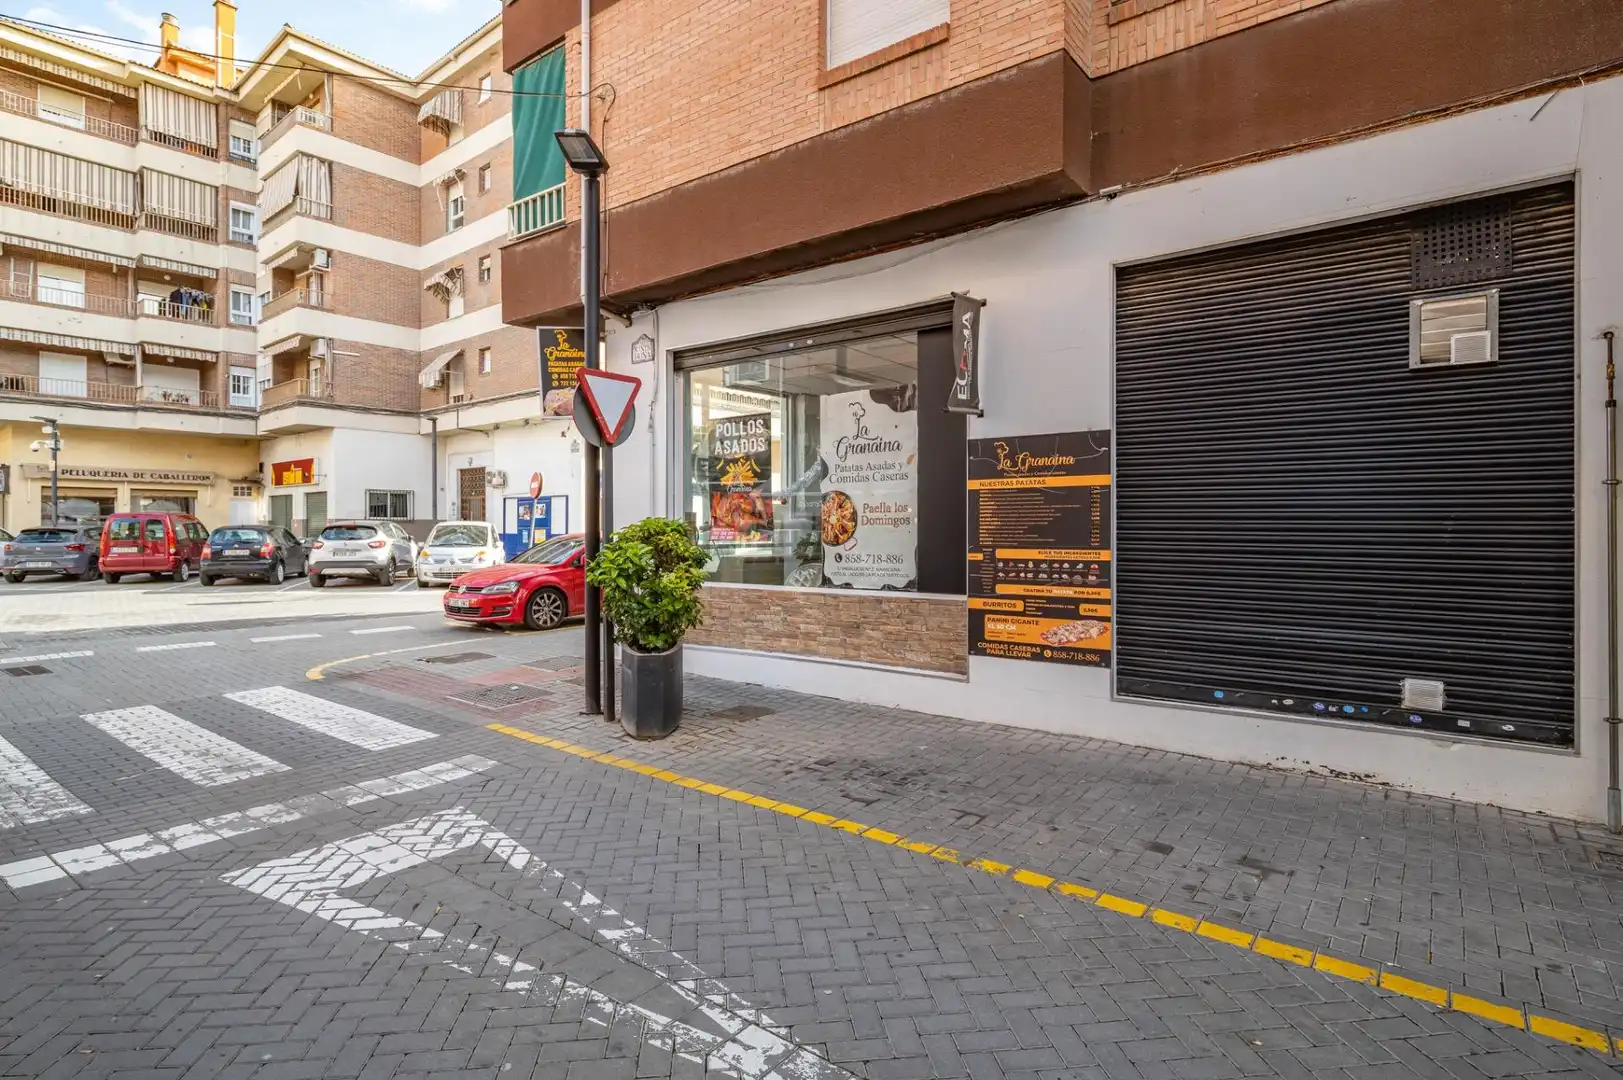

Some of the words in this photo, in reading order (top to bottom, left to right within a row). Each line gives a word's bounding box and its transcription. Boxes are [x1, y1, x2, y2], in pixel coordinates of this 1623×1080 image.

[544, 348, 585, 361] Granain
[715, 419, 764, 438] POLLOS
[852, 417, 877, 441] La
[714, 437, 766, 455] ASADOS
[832, 436, 903, 462] Granaina
[834, 463, 863, 473] Patatas
[865, 460, 896, 472] Asadas
[897, 462, 904, 470] y
[996, 453, 1018, 470] La
[1015, 452, 1076, 472] Granaina
[61, 468, 129, 479] PELUQUERIA
[132, 472, 146, 480] DE
[150, 472, 211, 481] CABALLEROS
[829, 472, 870, 484] Comidas
[872, 471, 909, 482] Caseras
[979, 480, 1014, 488] NUESTRAS
[863, 502, 891, 514] Paella
[894, 502, 909, 513] los
[861, 514, 911, 528] Domingos
[844, 553, 904, 565] 858-718-886
[982, 601, 1017, 609] BURRITOS
[977, 642, 1008, 651] COMIDAS
[1009, 645, 1041, 653] CASERAS
[1006, 650, 1032, 658] LLEVAR
[1053, 651, 1100, 663] 858-718-886
